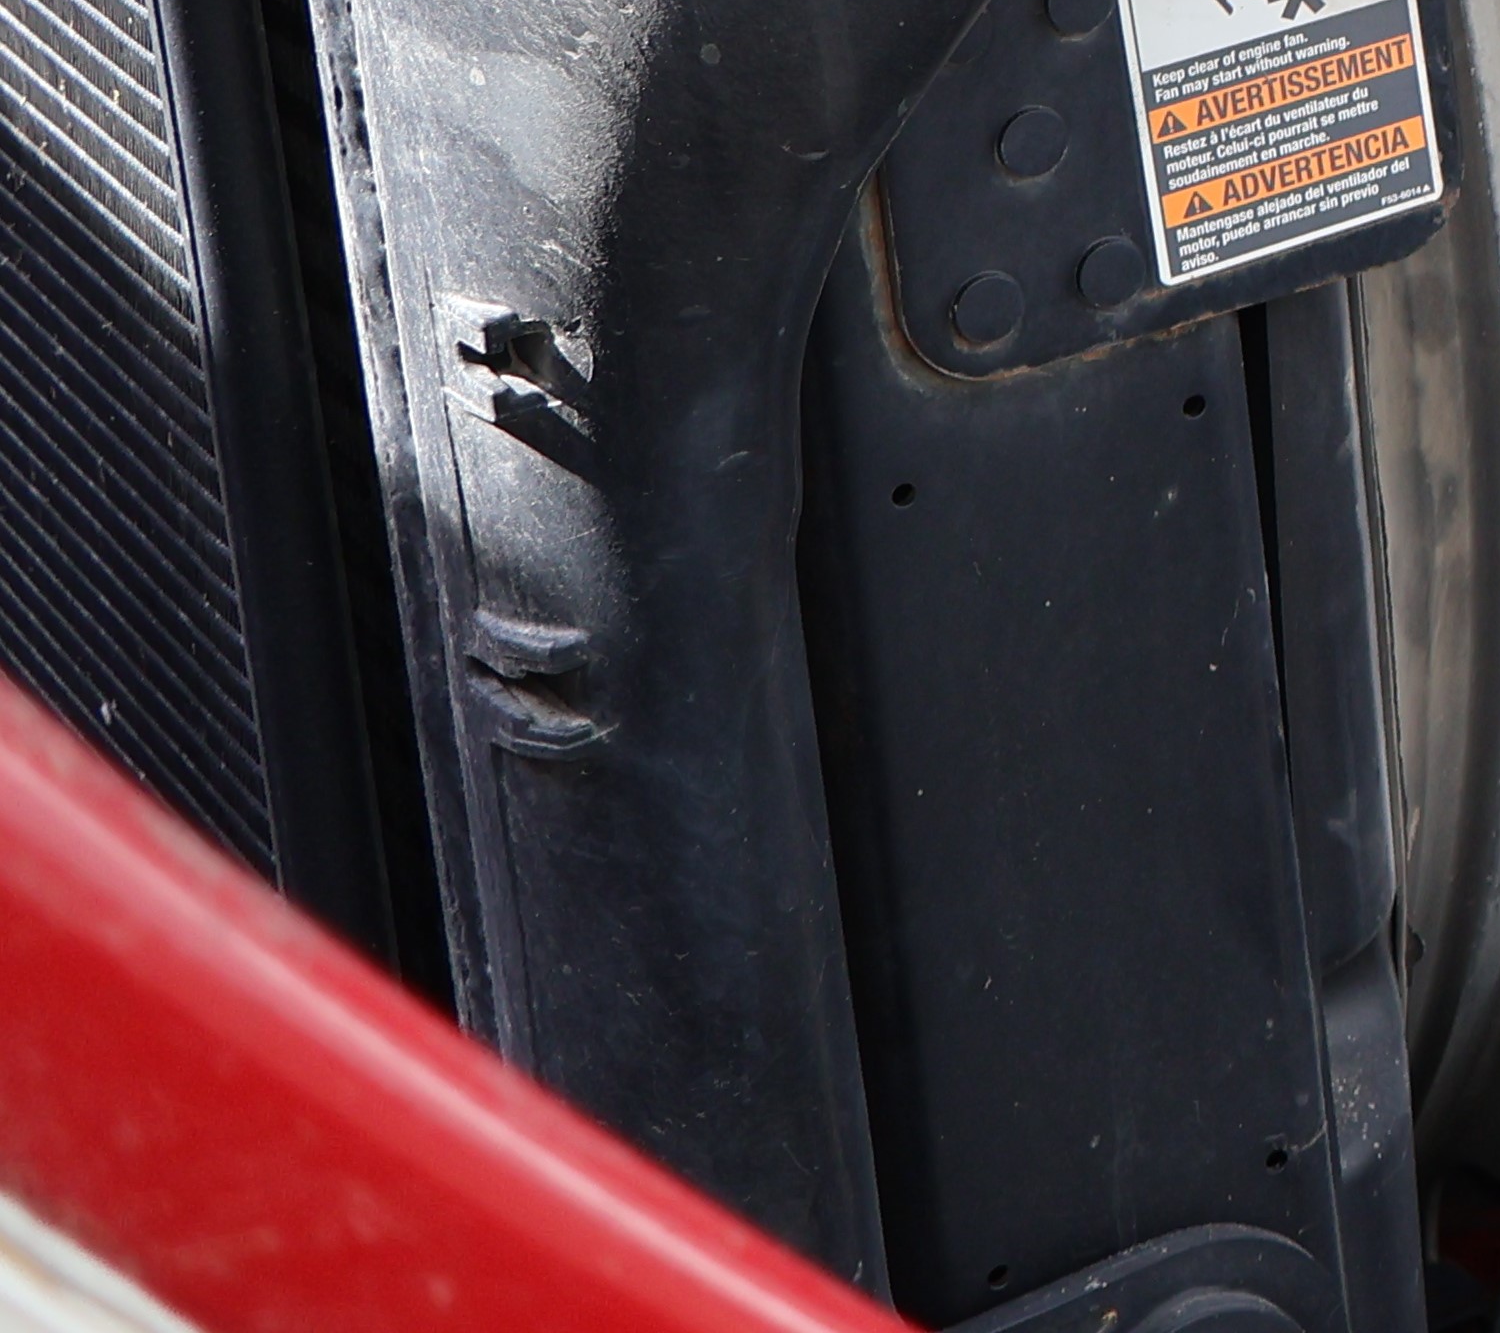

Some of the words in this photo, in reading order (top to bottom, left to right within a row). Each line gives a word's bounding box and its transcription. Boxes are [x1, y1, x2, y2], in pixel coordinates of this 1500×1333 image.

[1152, 65, 1186, 88] Keep
[1187, 55, 1220, 77] clear
[1222, 51, 1236, 67] of
[1238, 37, 1282, 64] engine
[1283, 30, 1307, 48] fan.
[1154, 84, 1180, 103] Fan
[1182, 77, 1209, 98] may
[1211, 65, 1242, 86] start
[1244, 50, 1293, 77] without
[1295, 35, 1350, 63] warning.
[1195, 37, 1408, 128] AVERTISSEMENT
[1163, 133, 1207, 160] Restez
[1209, 130, 1218, 145] à
[1220, 116, 1261, 142] l'écart
[1263, 111, 1281, 129] du
[1283, 90, 1350, 123] ventilateur
[1351, 85, 1368, 101] du
[1165, 148, 1214, 176] moteur.
[1216, 131, 1265, 160] Celui-ci
[1268, 116, 1318, 146] pourrait
[1320, 113, 1335, 127] se
[1337, 98, 1378, 122] mettre
[1168, 150, 1258, 192] soudainement
[1260, 146, 1276, 161] en
[1278, 128, 1330, 156] marche.
[1176, 205, 1254, 246] Mantengase
[1257, 190, 1303, 219] alejado
[1305, 184, 1324, 202] del
[1326, 163, 1388, 196] ventilador
[1390, 156, 1409, 174] del
[1222, 123, 1407, 208] ADVERTENCIA
[1178, 234, 1220, 260] motor,
[1221, 221, 1260, 246] puede
[1263, 203, 1316, 231] arrancar
[1318, 195, 1338, 212] sin
[1340, 182, 1379, 207] previo
[1180, 250, 1219, 272] aviso.
